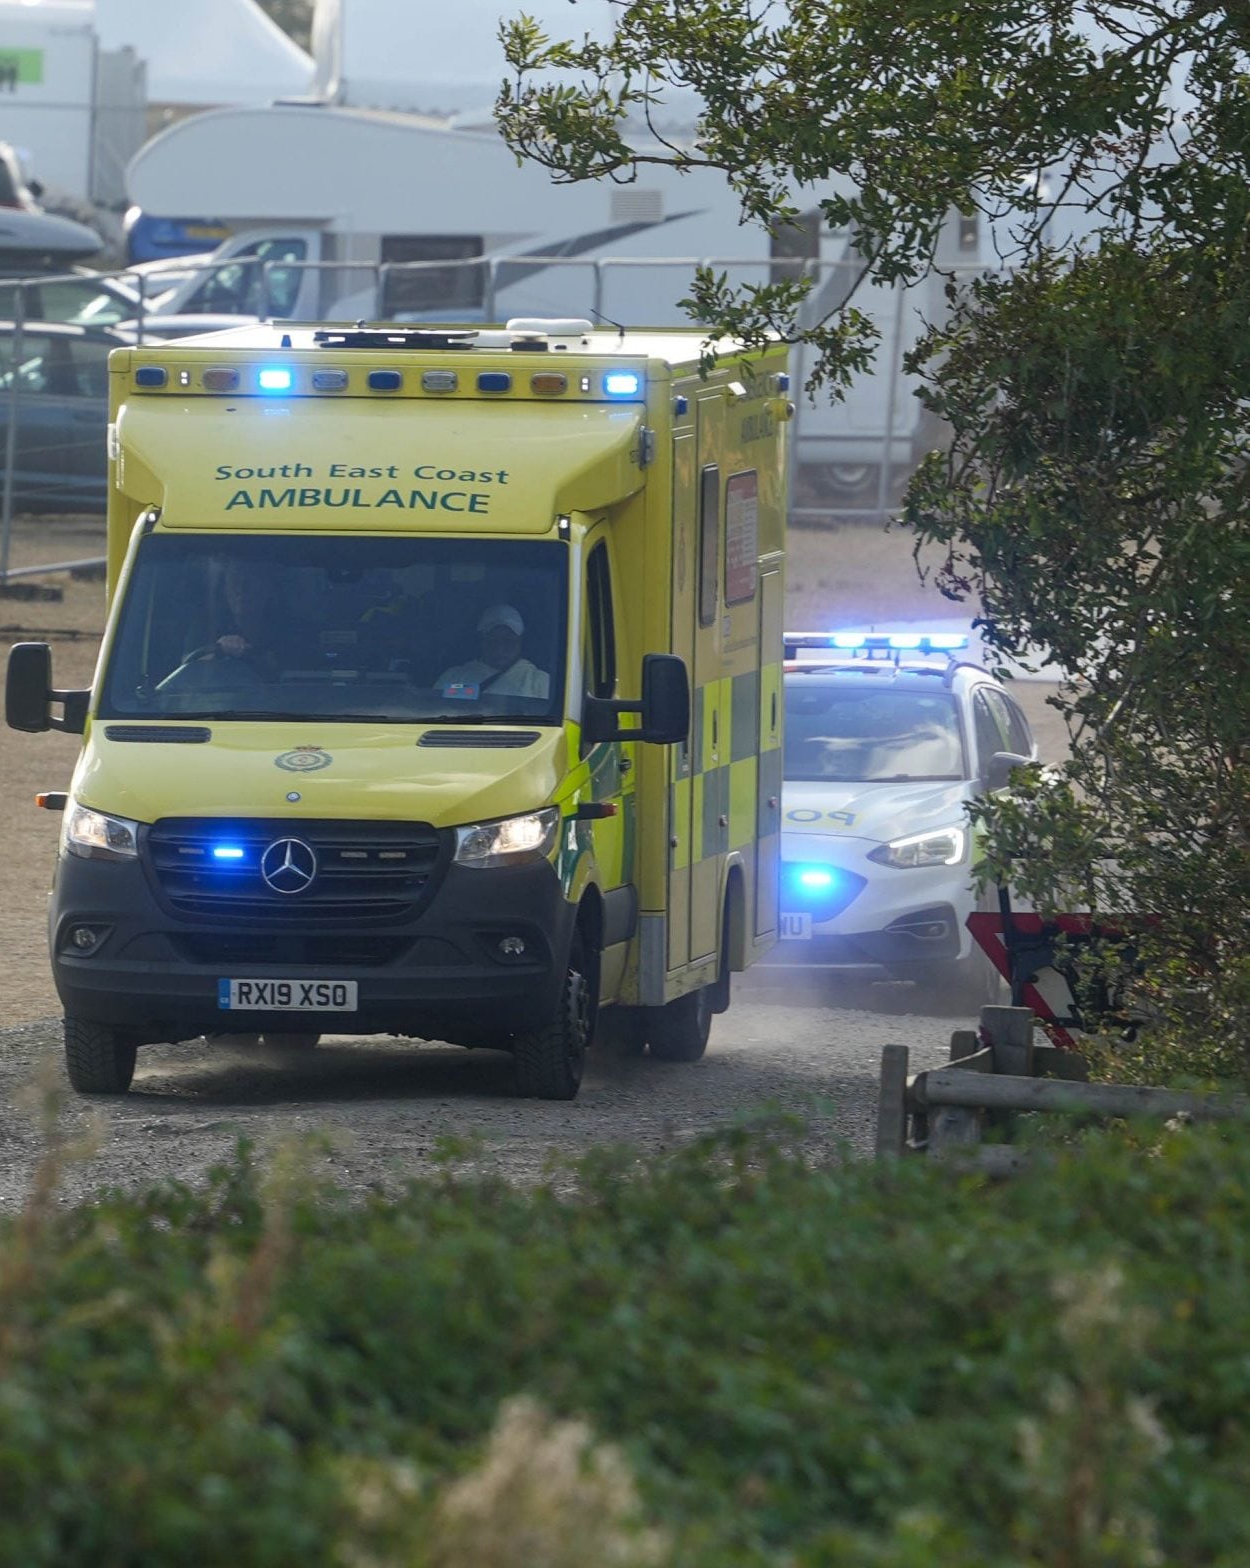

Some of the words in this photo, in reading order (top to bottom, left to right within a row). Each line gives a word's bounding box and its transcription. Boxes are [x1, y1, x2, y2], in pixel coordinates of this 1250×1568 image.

[214, 463, 313, 480] South
[329, 464, 399, 479] East
[413, 465, 510, 485] Coast
[224, 487, 492, 514] AMBULANCE
[237, 982, 292, 1006] RX19
[299, 983, 347, 1007] XSO
